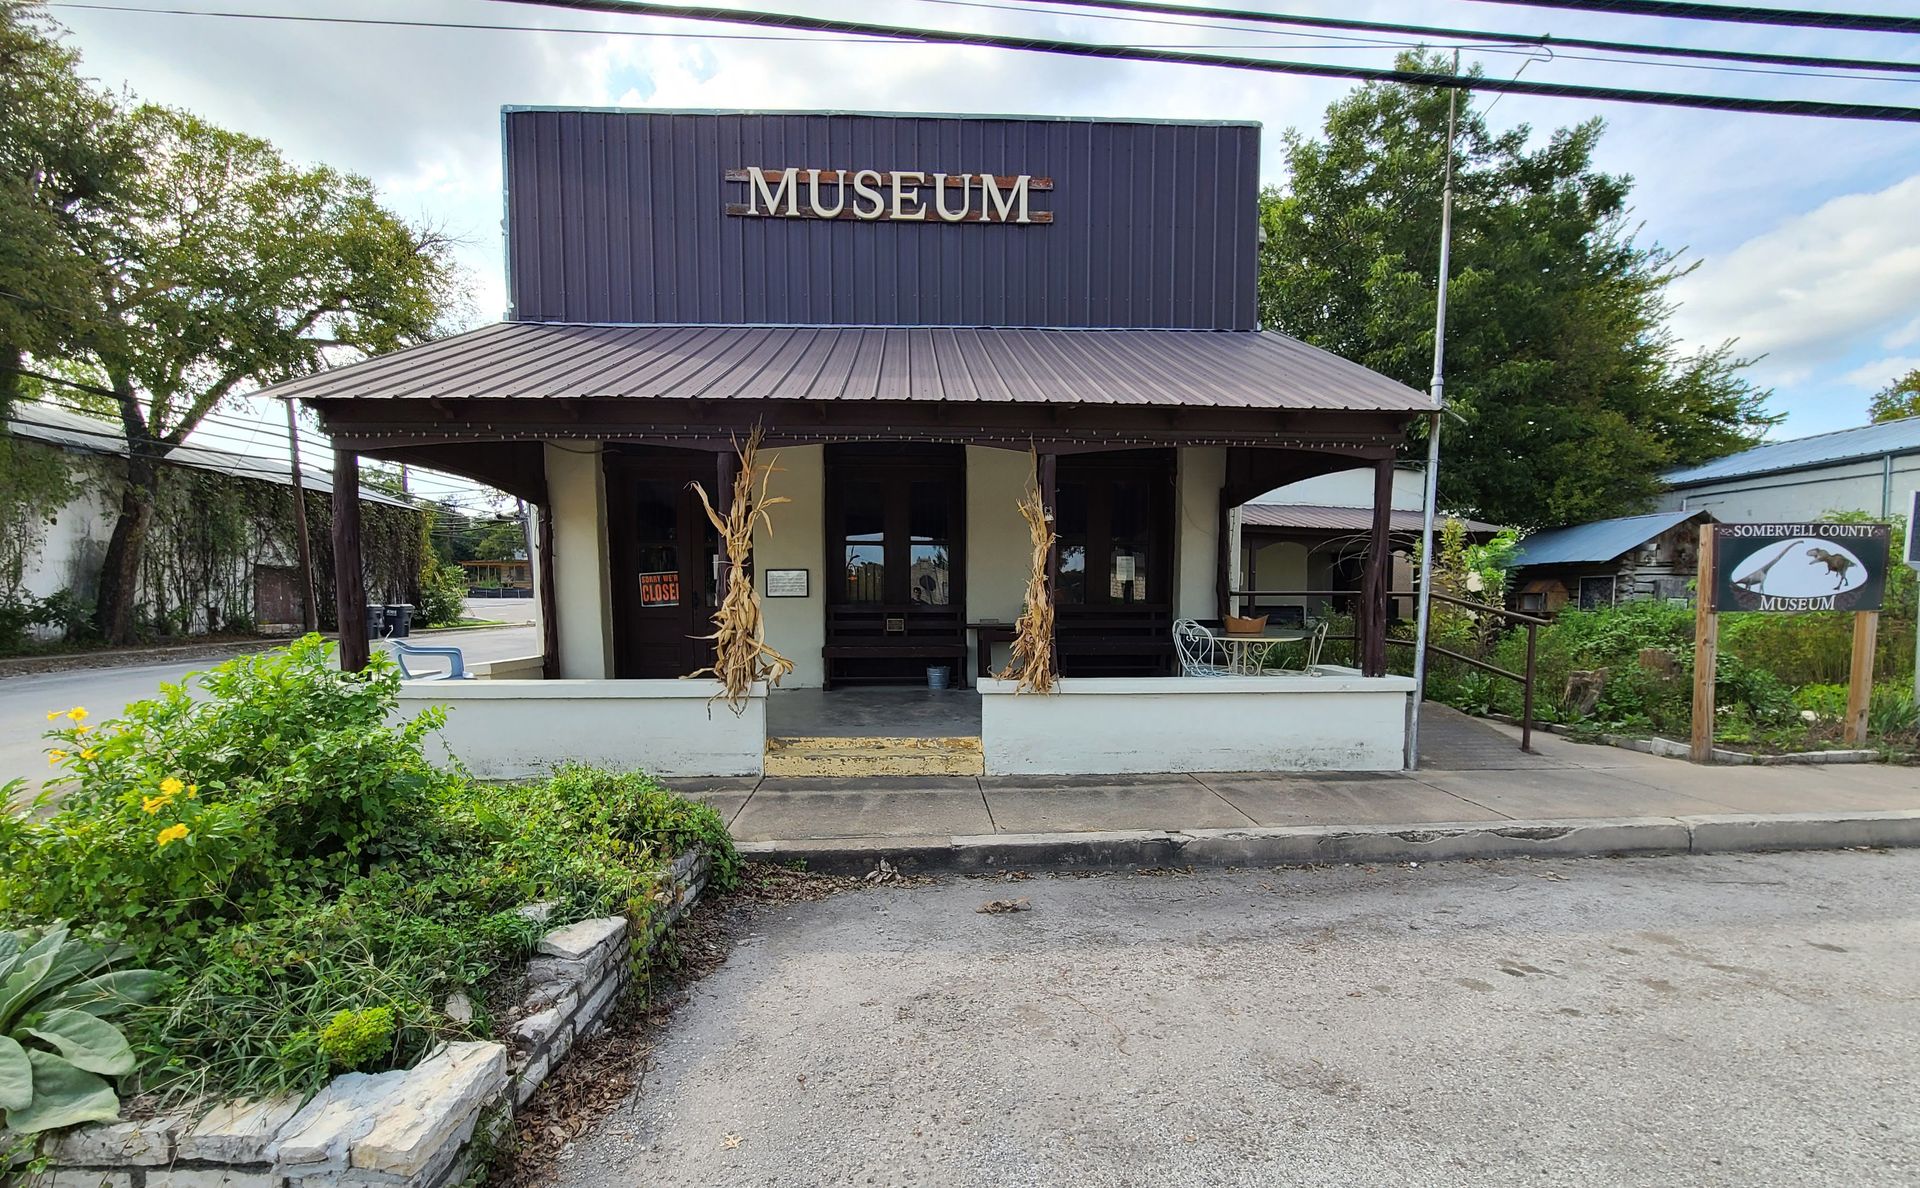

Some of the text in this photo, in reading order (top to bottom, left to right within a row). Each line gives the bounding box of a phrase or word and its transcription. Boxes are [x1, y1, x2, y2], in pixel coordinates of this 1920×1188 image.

[747, 166, 1032, 224] MUSEUM
[1734, 525, 1875, 537] SOMERVELL COUNTY
[641, 575, 661, 584] SORRY
[642, 583, 679, 601] CLOSE
[1759, 595, 1836, 611] MUSEUM
